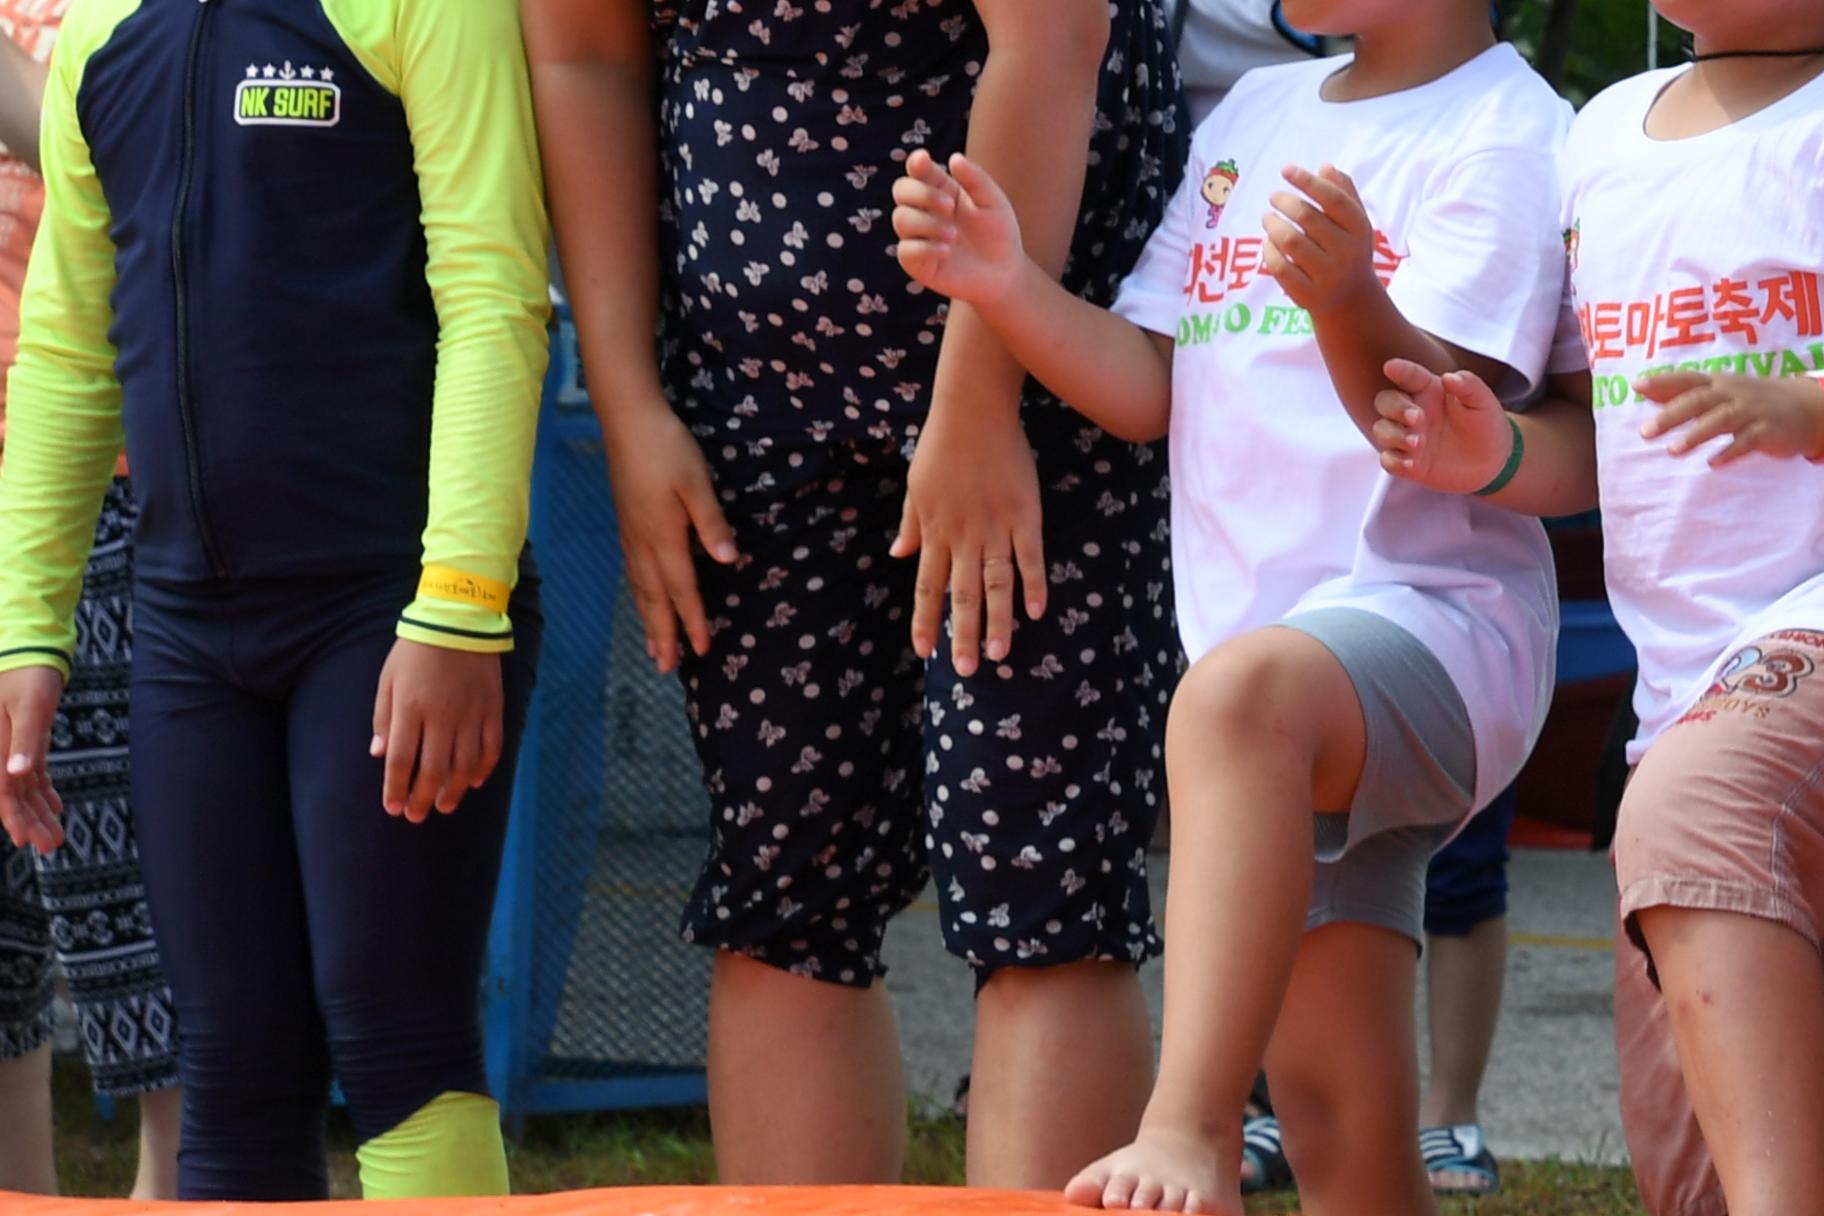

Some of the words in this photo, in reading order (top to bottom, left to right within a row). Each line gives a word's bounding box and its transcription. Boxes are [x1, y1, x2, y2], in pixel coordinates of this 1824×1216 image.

[241, 86, 270, 117] NK
[273, 87, 334, 119] SURF
[1578, 270, 1823, 370] 토마토축제
